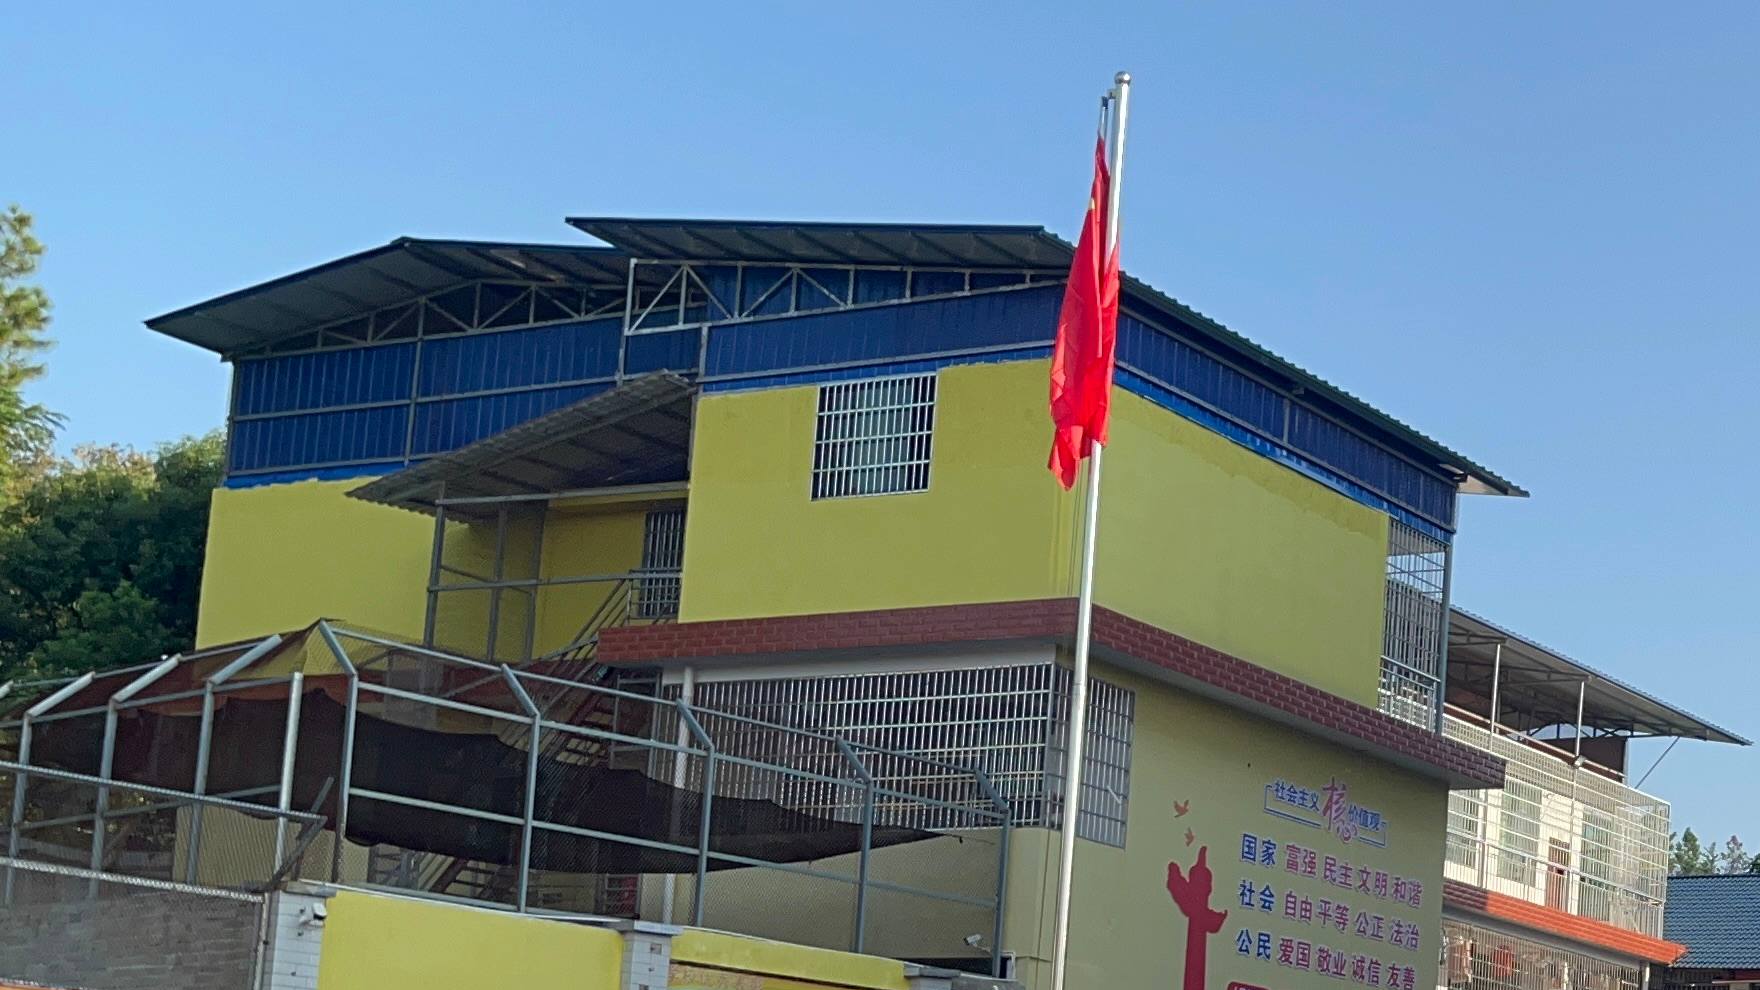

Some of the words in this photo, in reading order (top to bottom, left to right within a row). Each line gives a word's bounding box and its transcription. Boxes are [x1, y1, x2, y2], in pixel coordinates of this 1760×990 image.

[1241, 833, 1277, 867] 国家
[1285, 843, 1317, 876] 富强
[1323, 855, 1353, 888] 民主
[1357, 865, 1389, 899] 文明
[1392, 875, 1423, 907] 和谐
[1239, 879, 1275, 913] 社会
[1284, 890, 1314, 923] 自由
[1317, 898, 1350, 932] 平等
[1355, 911, 1386, 940] 公正
[1390, 918, 1421, 950] 法治
[1236, 928, 1273, 961] 公民
[1279, 937, 1312, 970] 爱国
[1316, 946, 1348, 979] 敬业
[1352, 953, 1383, 987] 诚信
